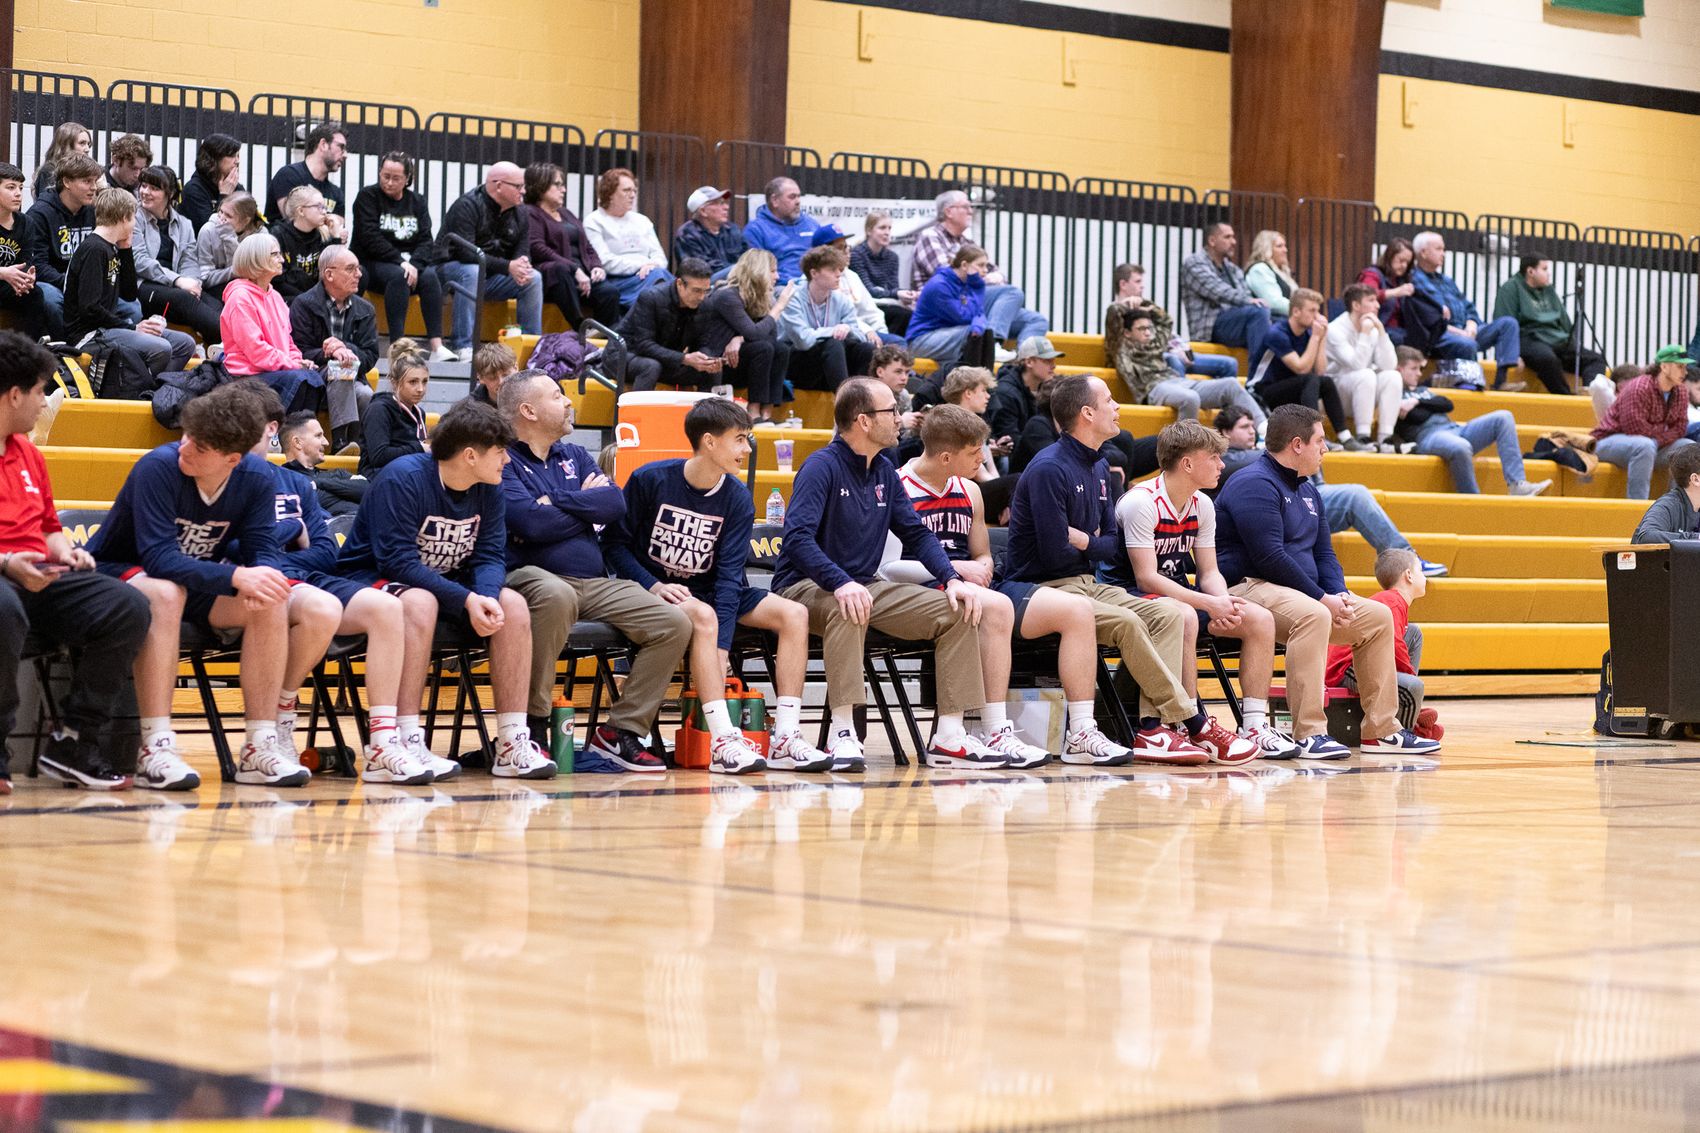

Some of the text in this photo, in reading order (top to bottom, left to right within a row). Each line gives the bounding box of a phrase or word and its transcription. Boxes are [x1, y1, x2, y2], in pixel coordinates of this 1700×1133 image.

[799, 205, 823, 217] HANK
[436, 521, 472, 544] THE
[671, 511, 713, 540] THE
[921, 512, 945, 534] ATE
[179, 541, 220, 556] RIOT
[651, 525, 717, 553] PATRIO
[660, 542, 711, 570] WAY
